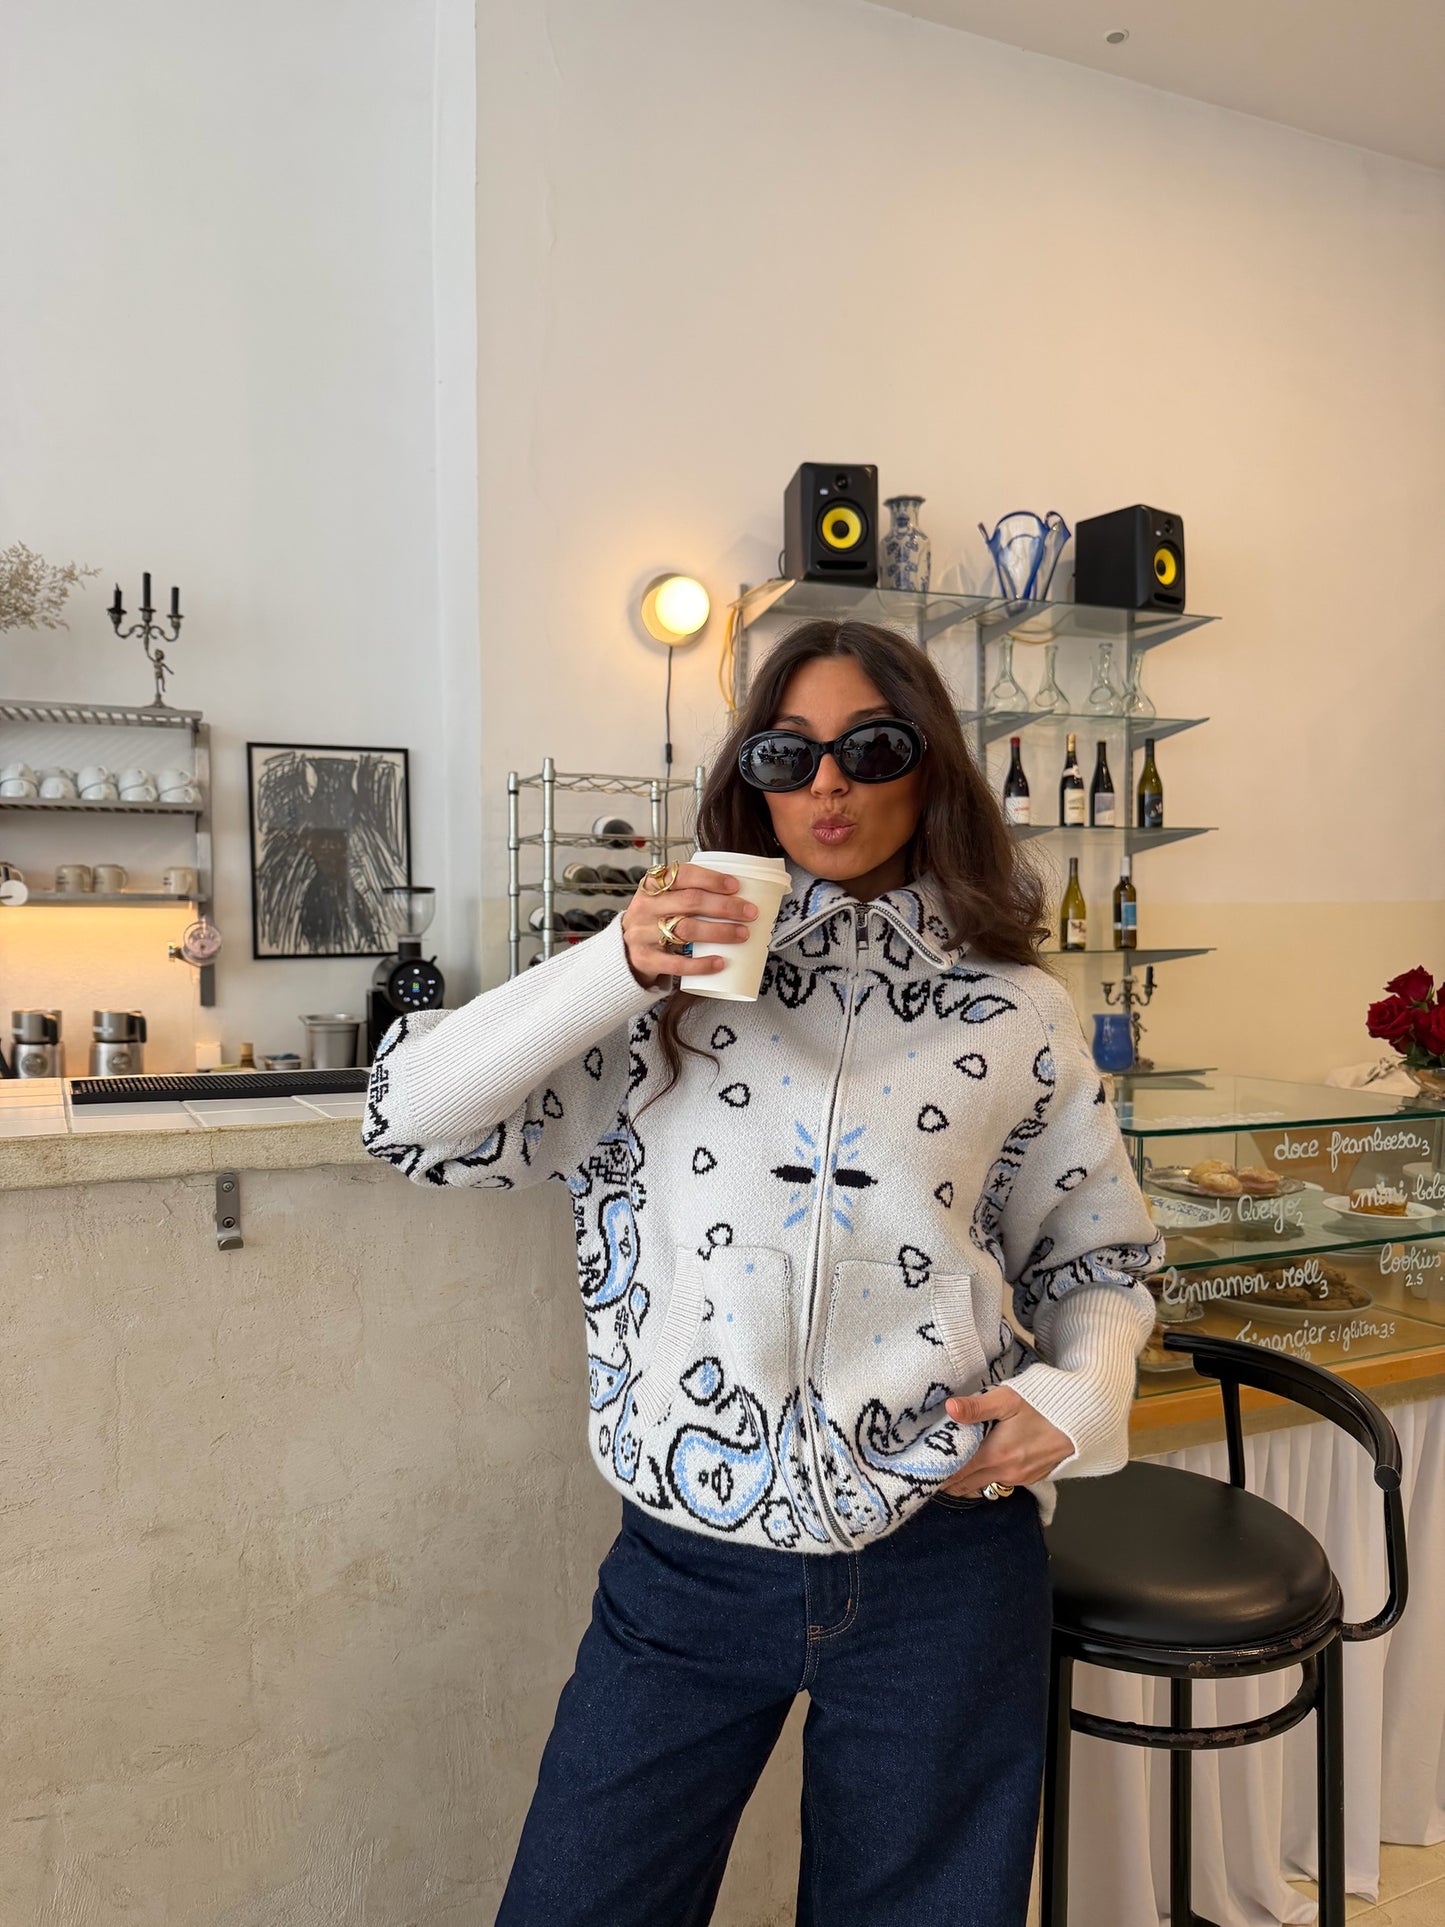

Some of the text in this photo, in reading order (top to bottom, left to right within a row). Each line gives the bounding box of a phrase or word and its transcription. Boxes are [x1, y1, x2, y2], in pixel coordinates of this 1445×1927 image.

[1274, 1127, 1430, 1173] doce framboesa 3
[1296, 1211, 1305, 1226] 2
[1380, 1242, 1441, 1274] Cookies
[1162, 1259, 1329, 1305] Cinnamon roll 3
